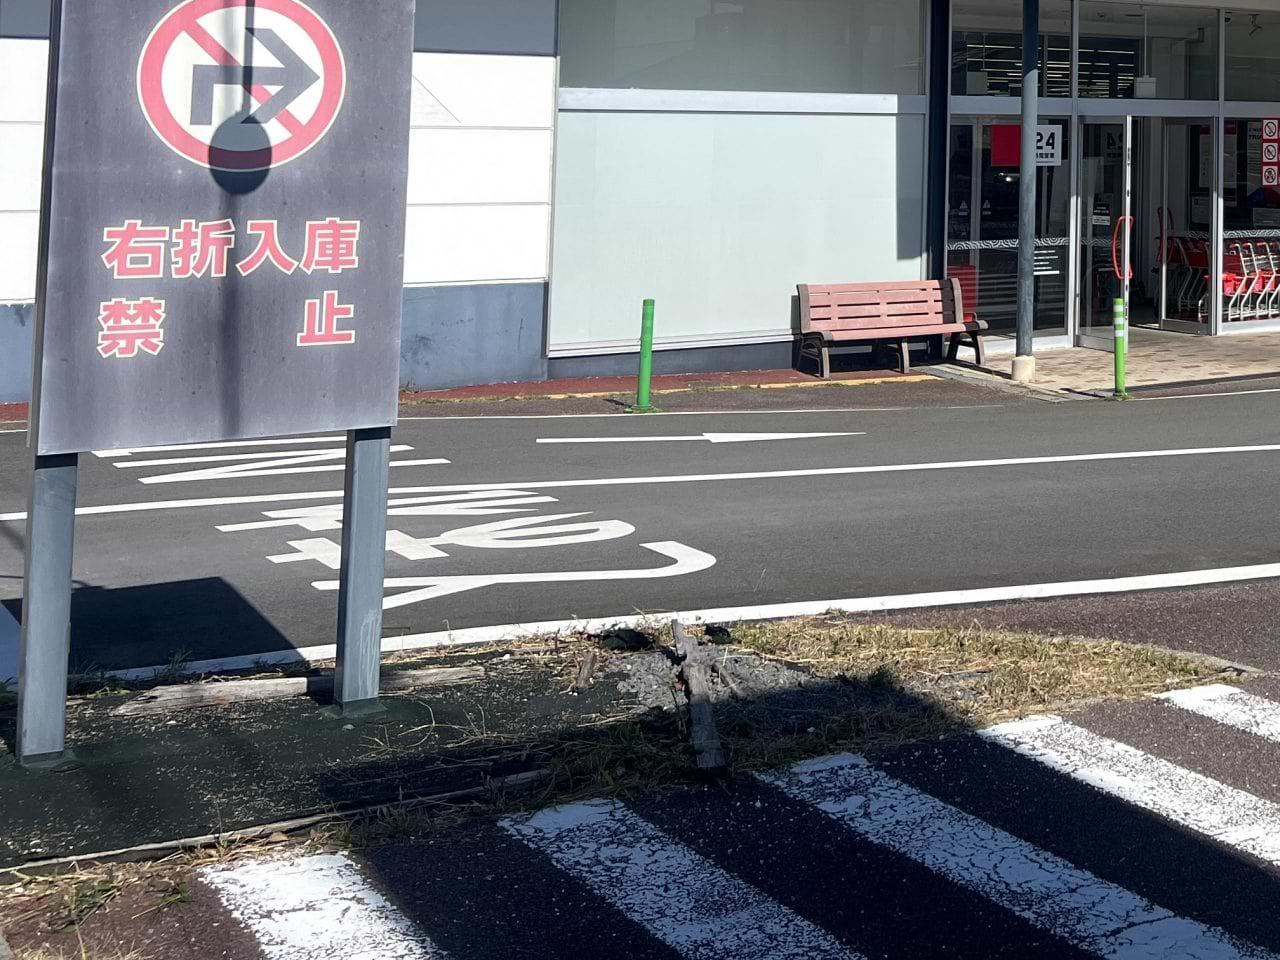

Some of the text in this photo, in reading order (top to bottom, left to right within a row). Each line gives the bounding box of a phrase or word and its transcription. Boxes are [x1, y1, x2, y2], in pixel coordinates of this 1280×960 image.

[1036, 131, 1055, 150] 24
[102, 217, 361, 279] 右折入庫
